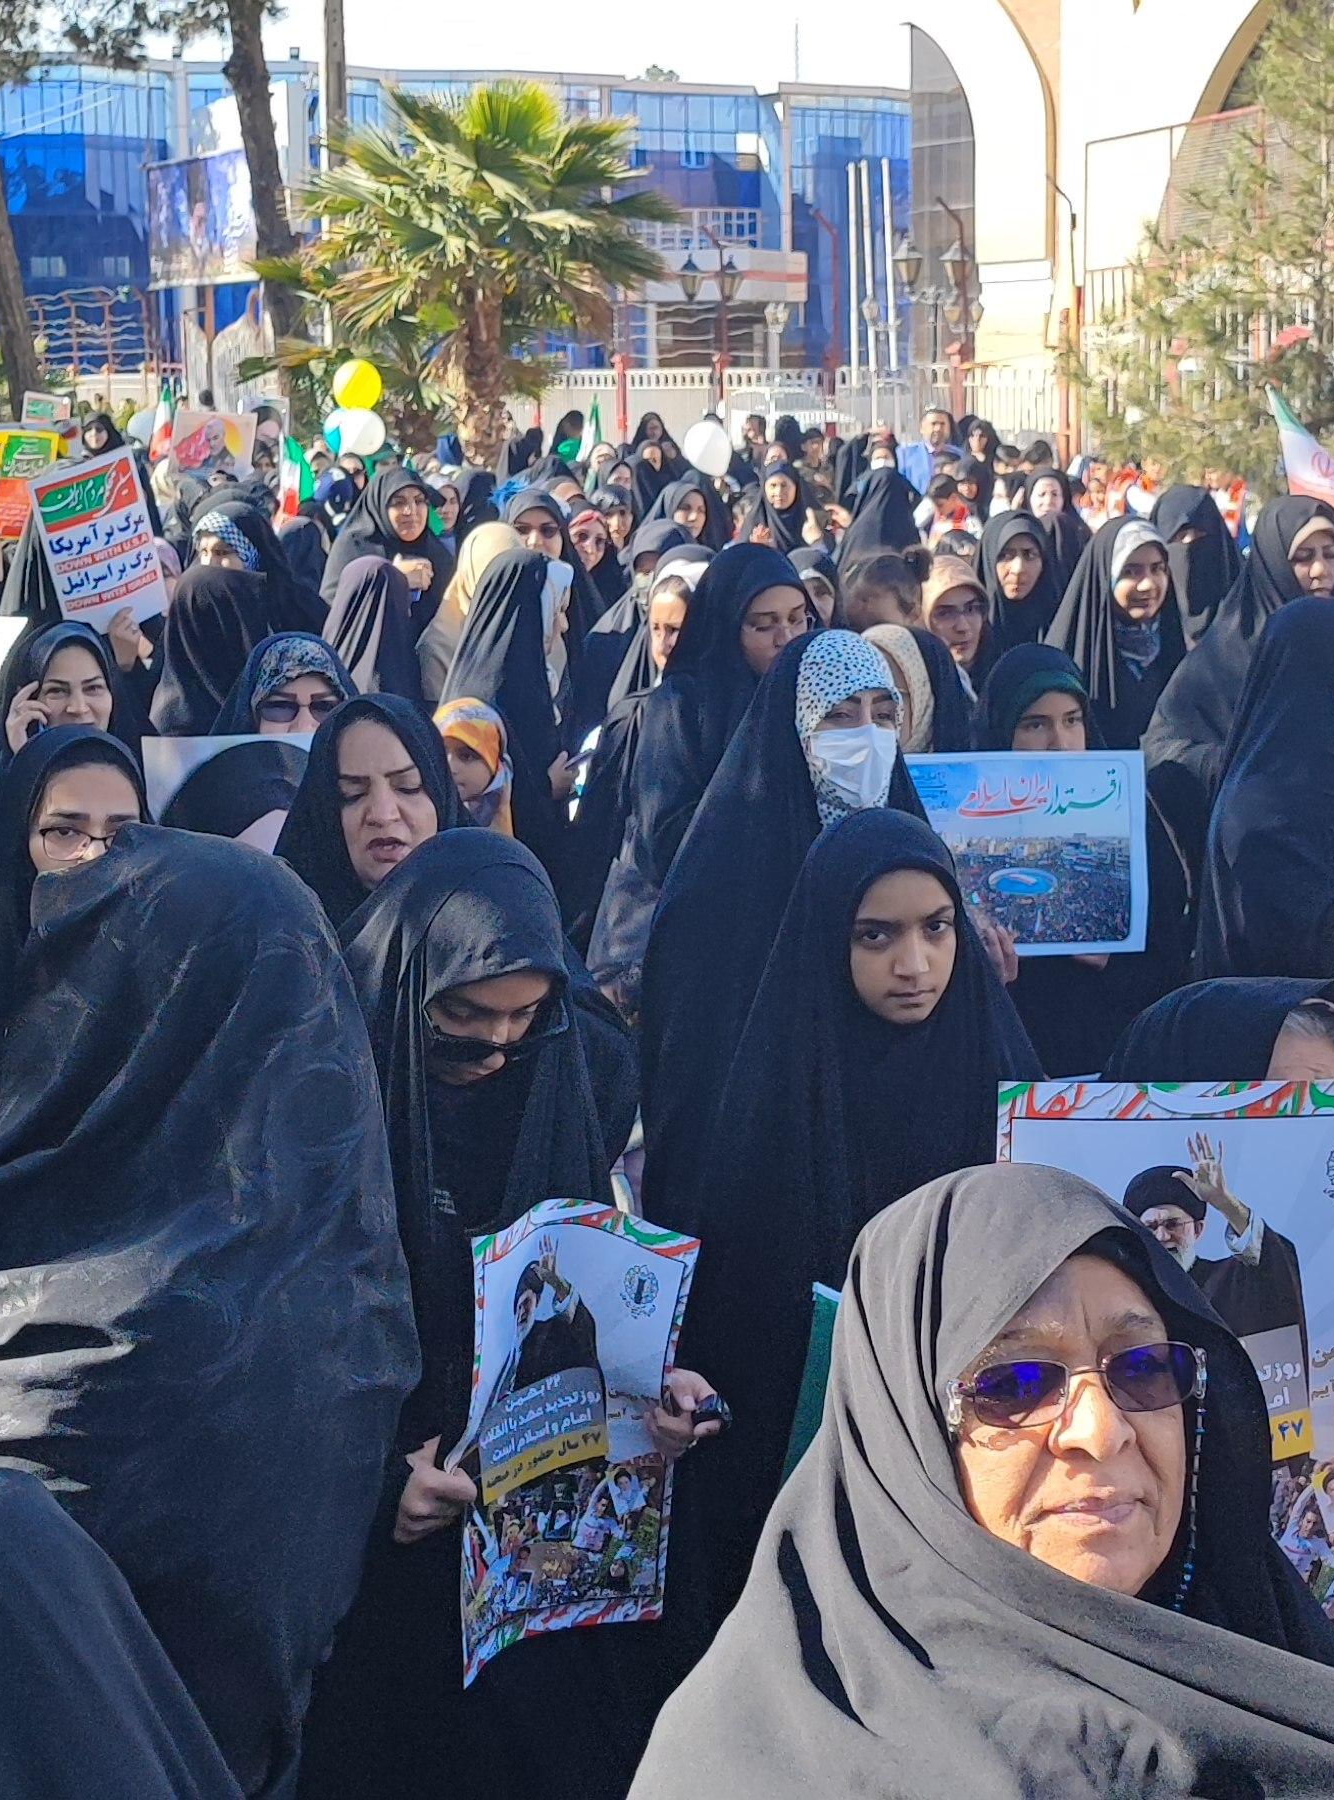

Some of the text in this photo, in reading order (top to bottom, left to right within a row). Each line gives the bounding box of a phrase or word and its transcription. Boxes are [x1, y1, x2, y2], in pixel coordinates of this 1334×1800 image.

[48, 511, 145, 557] مرگ بر آمریکا
[1273, 1361, 1302, 1383] روز
[580, 1430, 602, 1446] ۴۷
[1277, 1418, 1303, 1442] ۴۷
[558, 1437, 580, 1457] سال
